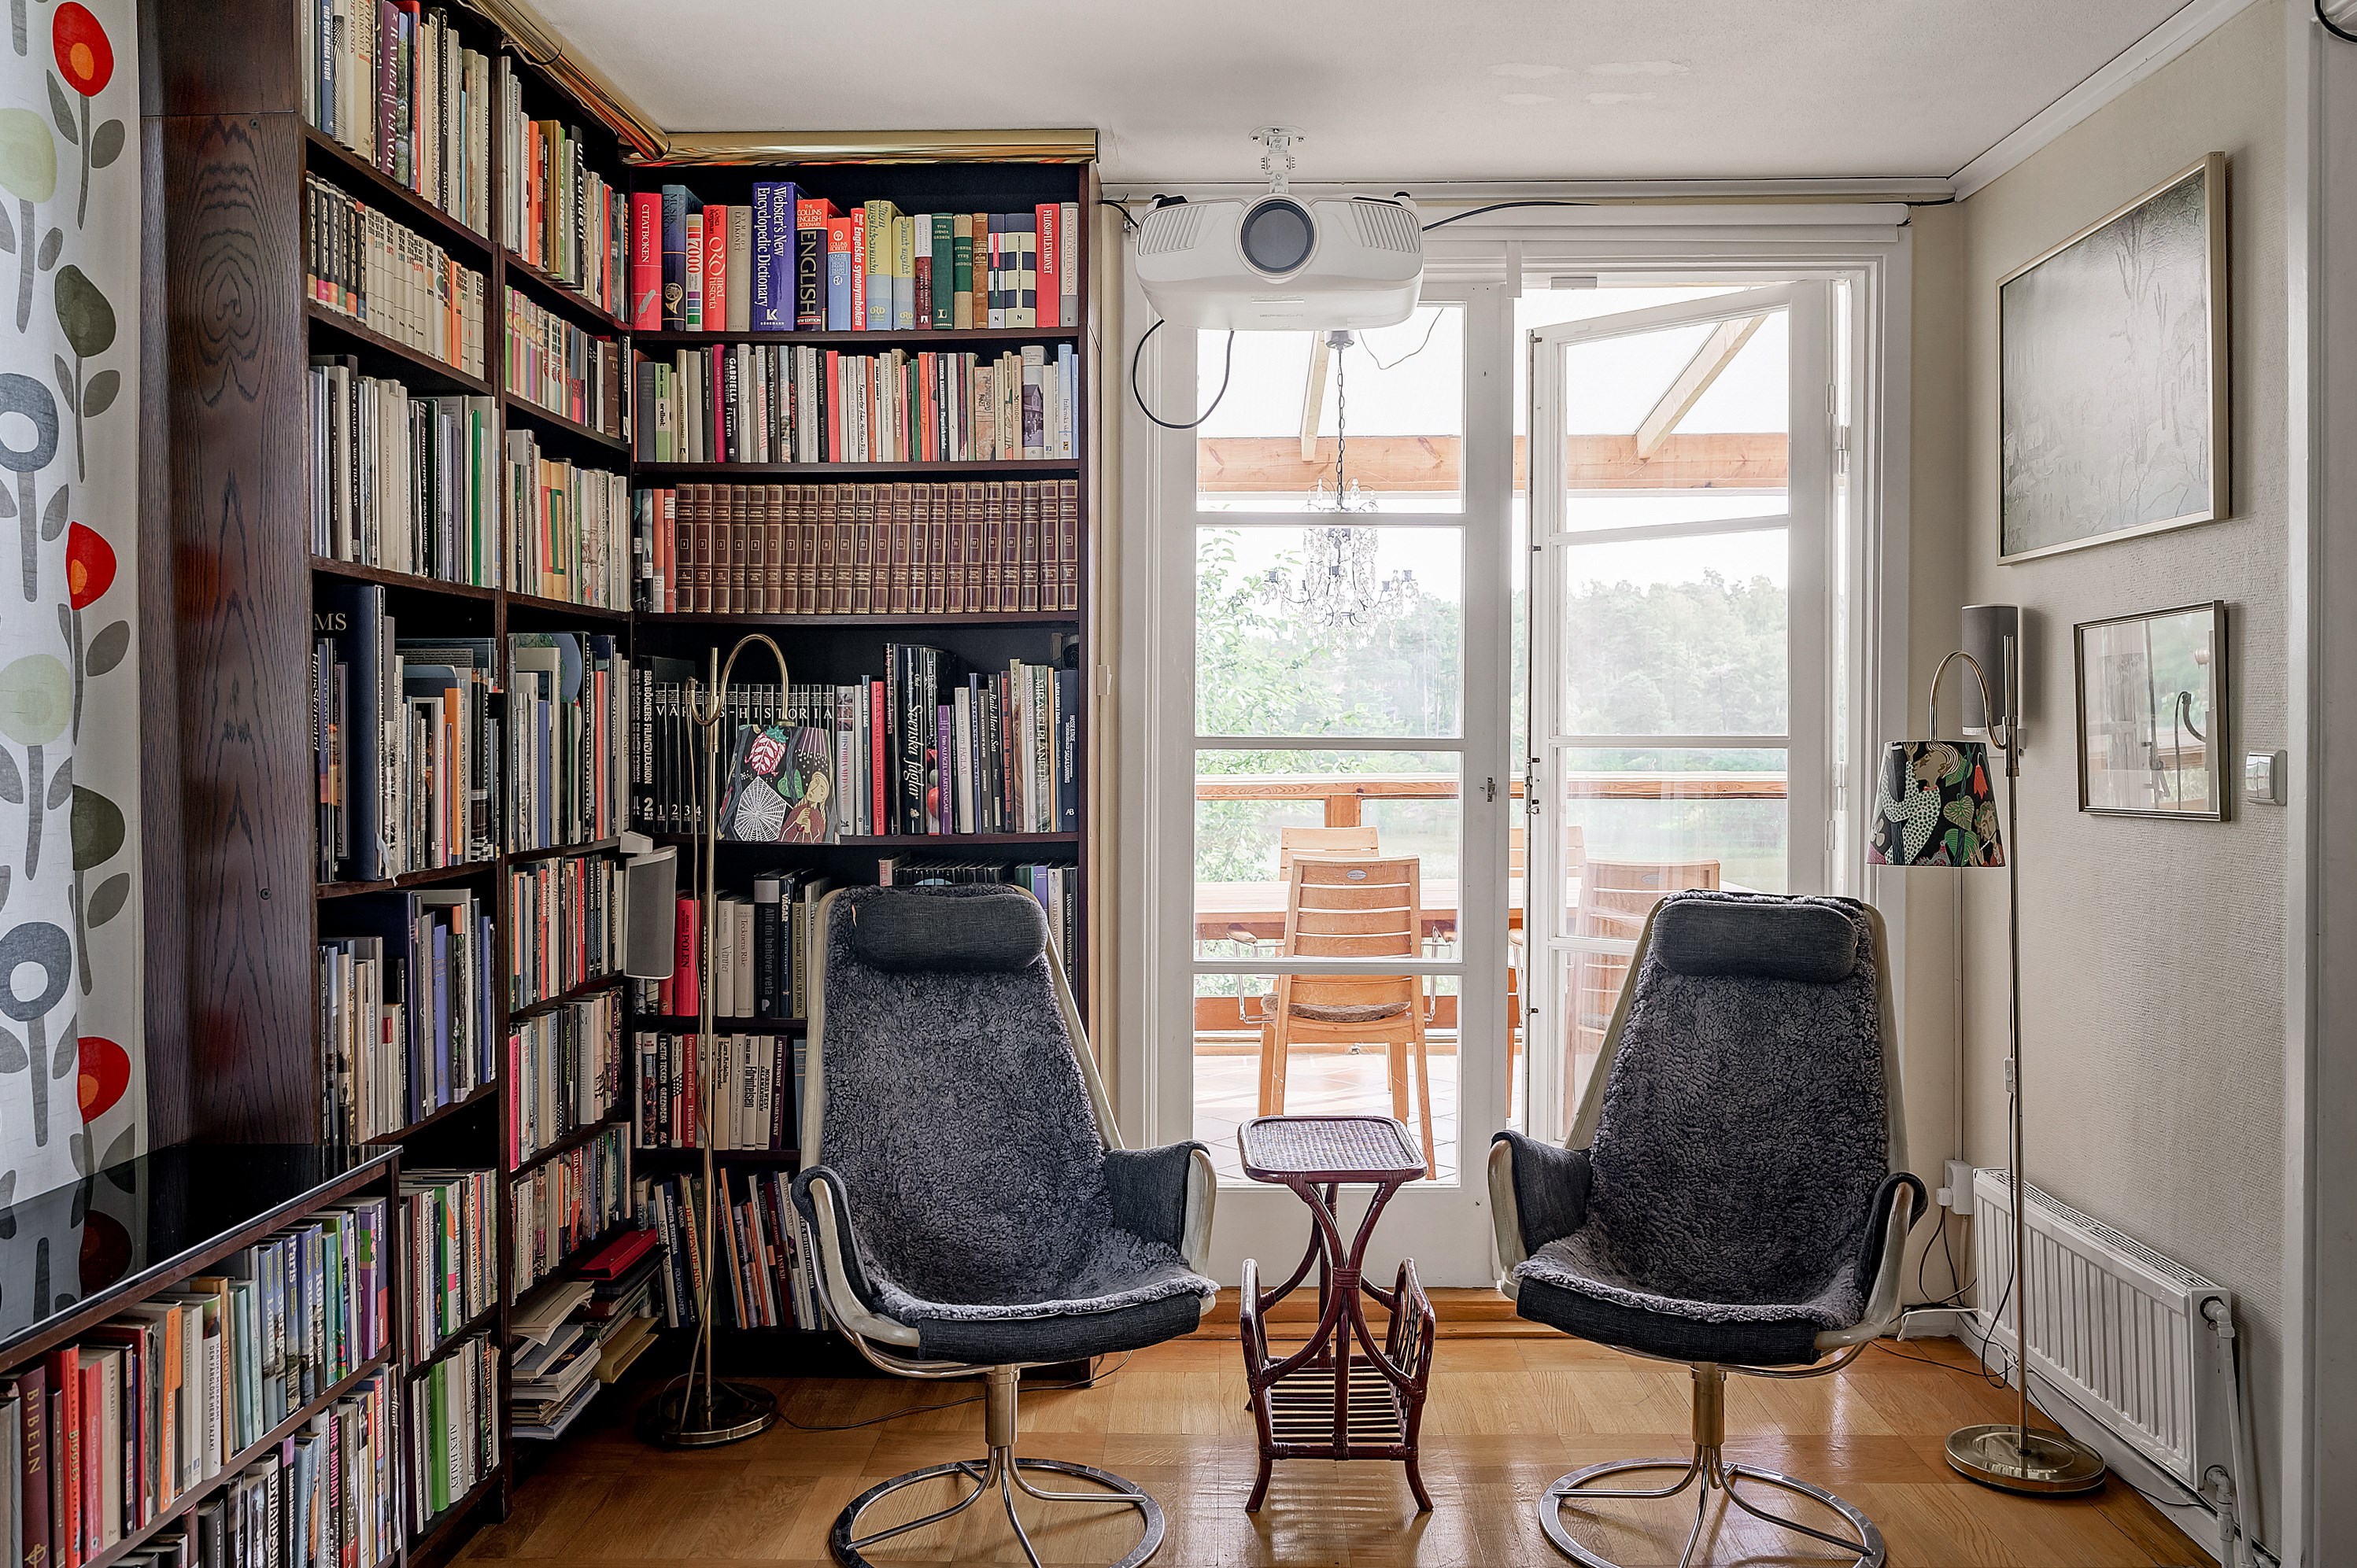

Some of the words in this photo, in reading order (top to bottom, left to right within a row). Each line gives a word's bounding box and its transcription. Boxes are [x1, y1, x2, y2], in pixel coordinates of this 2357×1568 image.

[389, 26, 397, 90] RAMEL
[387, 110, 397, 171] POVEL
[755, 187, 771, 253] Encyclopedic
[773, 186, 788, 233] Webster's
[878, 204, 888, 227] Stora
[774, 234, 786, 256] New
[853, 227, 864, 263] Engelska
[868, 204, 878, 273] engelsk-svenska
[901, 221, 910, 246] Svensk
[1043, 210, 1053, 275] FILOSOFILEXIKONET
[687, 241, 700, 273] 7000
[708, 237, 726, 276] ORD
[800, 231, 816, 315] ENGLISH
[900, 248, 910, 275] engelsk
[708, 277, 717, 309] historia
[755, 254, 771, 307] Dictionary
[853, 265, 863, 326] synonymboken
[664, 497, 674, 519] NVH
[644, 687, 652, 721] BÖCKERS
[907, 703, 922, 755] Svenska
[1035, 678, 1046, 789] MIRAKELPLANETEN
[903, 757, 924, 799] fåglar
[645, 797, 653, 811] 2
[658, 806, 663, 815] 1
[671, 804, 678, 815] 2
[685, 805, 690, 815] 3
[696, 805, 702, 815] 4
[765, 908, 774, 922] Allt
[781, 893, 790, 922] VÄGAR
[765, 925, 774, 935] du
[681, 935, 689, 968] POLEN
[765, 938, 774, 973] behöver
[765, 976, 774, 994] veta
[744, 1066, 757, 1108] Förintelsen
[688, 1226, 698, 1266] ÖPPNADE
[777, 1255, 785, 1281] LYSEKIL
[806, 1260, 815, 1289] COLUMBIA
[26, 1387, 41, 1474] BIBELN
[329, 1413, 338, 1449] LIANE
[68, 1430, 79, 1482] BIGGLES
[330, 1452, 339, 1509] MORIARTY
